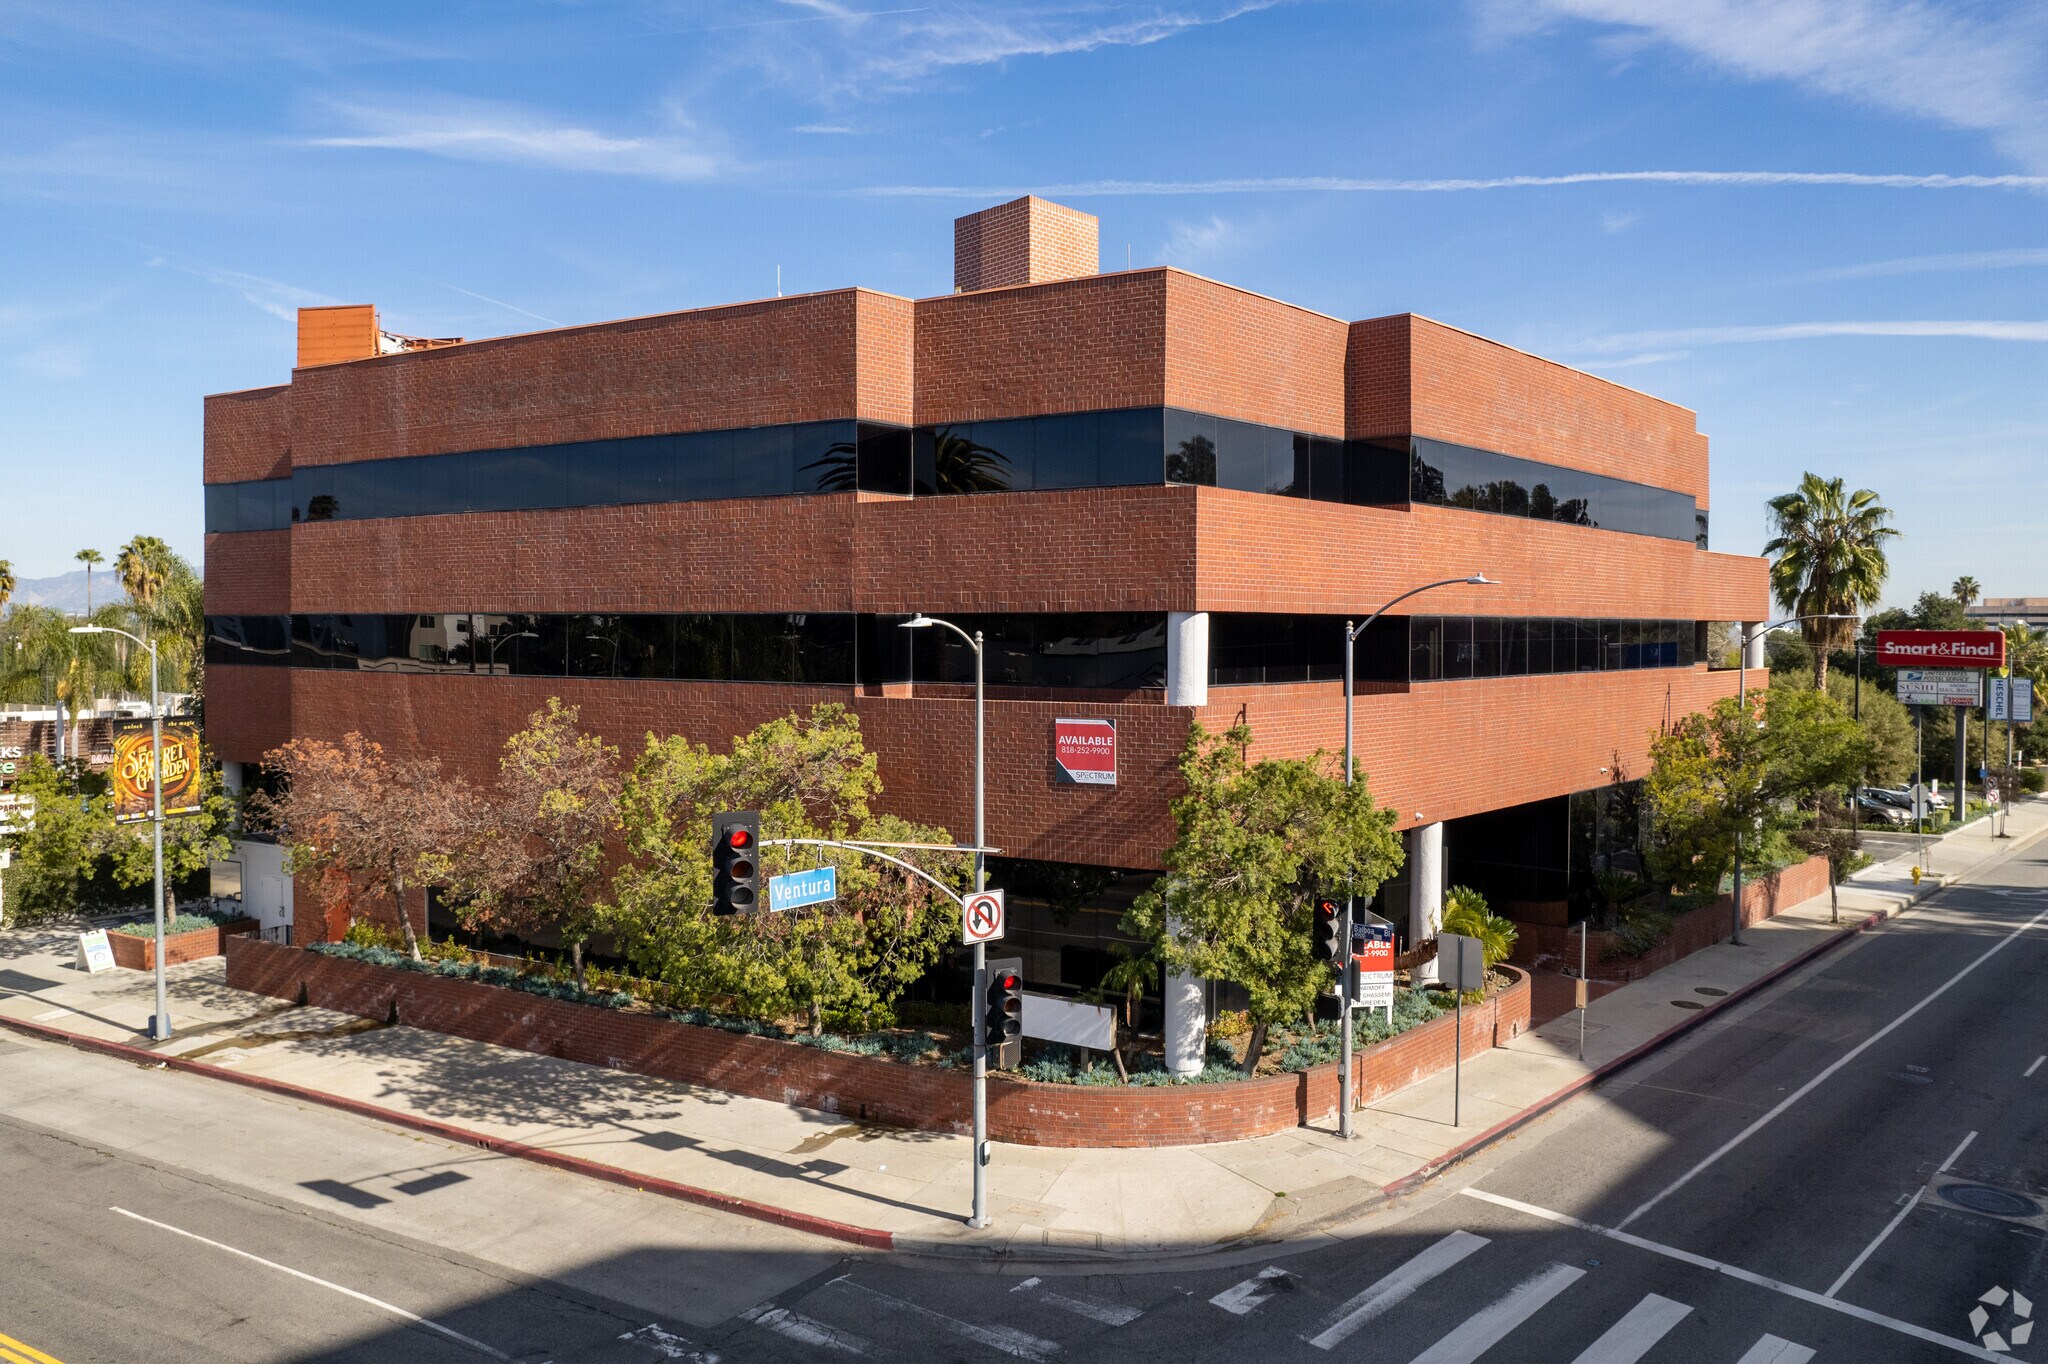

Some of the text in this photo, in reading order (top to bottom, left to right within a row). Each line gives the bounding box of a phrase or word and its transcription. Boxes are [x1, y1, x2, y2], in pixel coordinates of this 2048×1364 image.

[1885, 642, 1994, 656] Smart&Final
[179, 720, 195, 728] magic
[1058, 735, 1113, 746] AVAILABLE
[1061, 746, 1110, 755] 818-252-9900
[122, 742, 184, 779] SECRET
[136, 758, 190, 791] GARDEN
[1076, 771, 1115, 780] SPECTRUM
[775, 880, 831, 901] Ventura
[1353, 925, 1391, 938] Balboa Bl
[1360, 972, 1392, 980] PECTRUM
